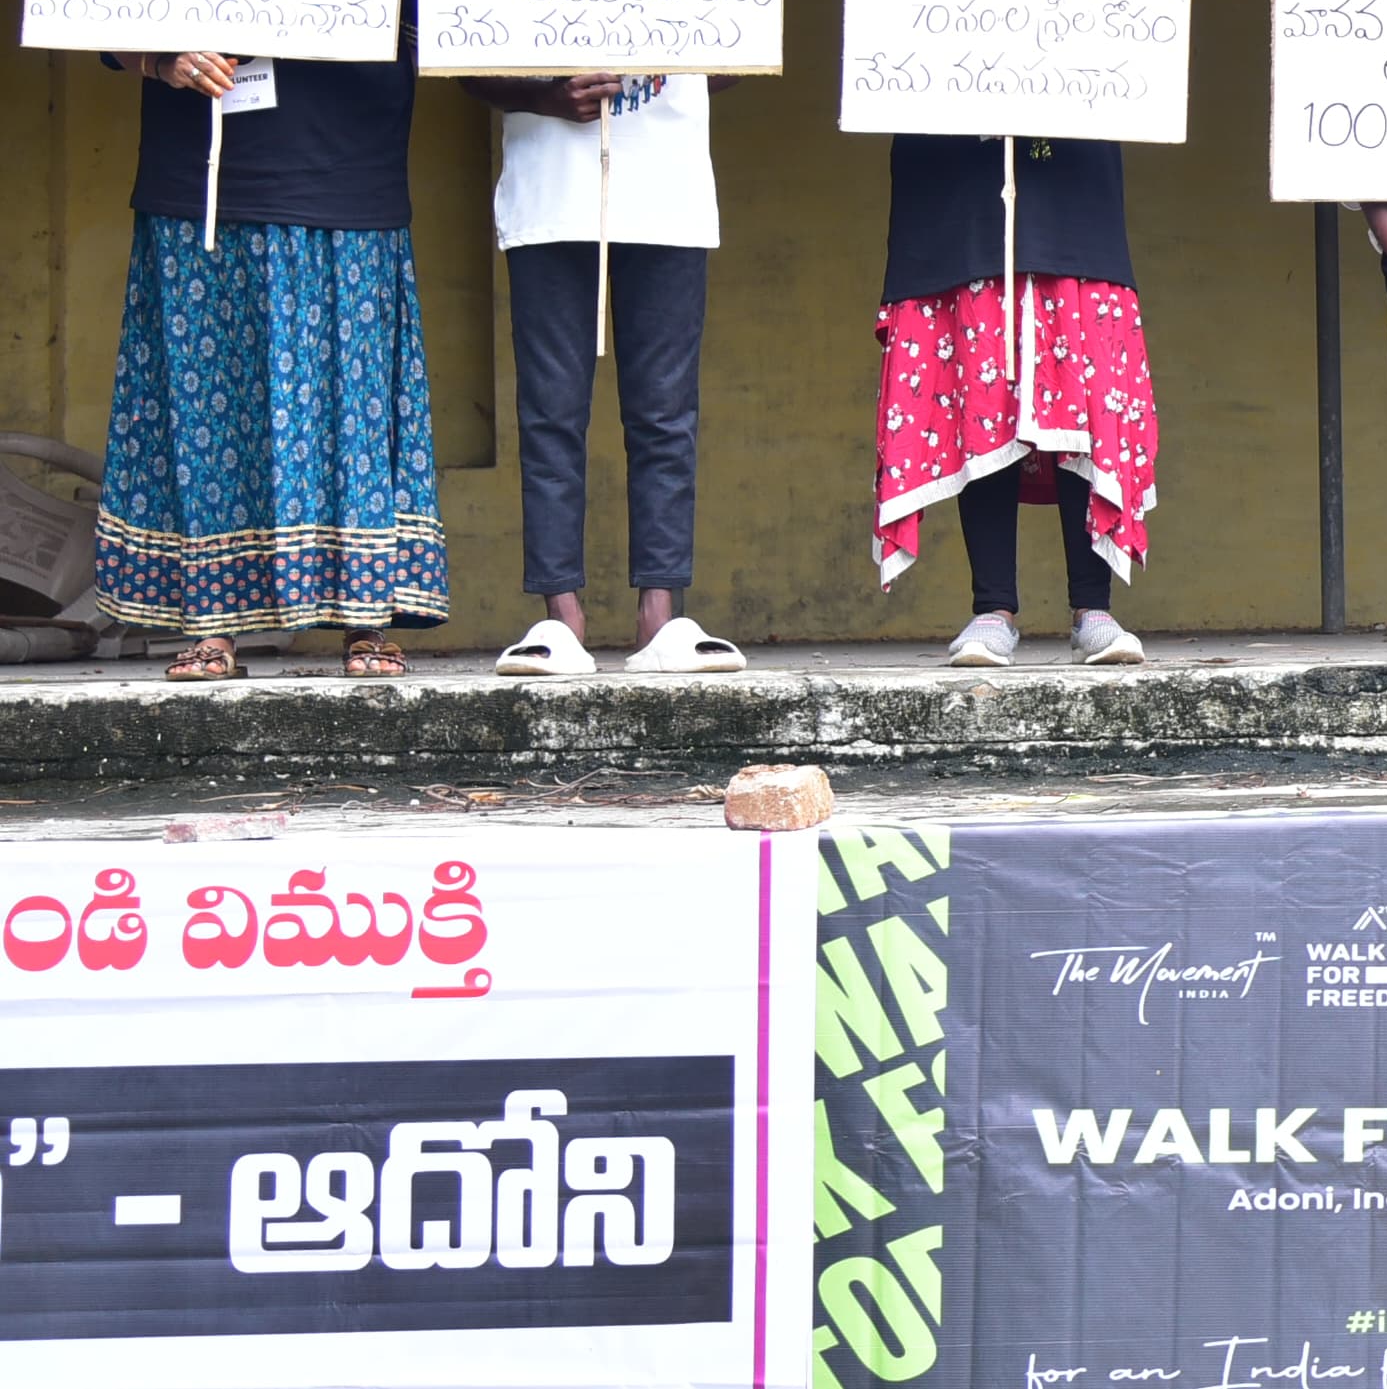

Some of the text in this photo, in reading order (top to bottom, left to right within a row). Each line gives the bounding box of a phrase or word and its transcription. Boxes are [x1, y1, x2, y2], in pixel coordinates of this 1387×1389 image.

[437, 6, 509, 48] నేను
[1102, 0, 1177, 43] కోసం
[231, 73, 268, 84] LUNTEER
[855, 52, 931, 92] నేను
[181, 860, 492, 998] విముక్తి
[1306, 944, 1387, 962] WALK
[1110, 942, 1284, 1025] Movement
[1178, 989, 1230, 1000] INDIA
[1306, 966, 1360, 984] FOR
[1031, 1107, 1317, 1165] WALK
[229, 1089, 676, 1273] ఆదోని
[1228, 1187, 1343, 1213] Adoni,
[1024, 1352, 1087, 1389] for
[1109, 1366, 1182, 1381] an
[1197, 1335, 1366, 1389] India
